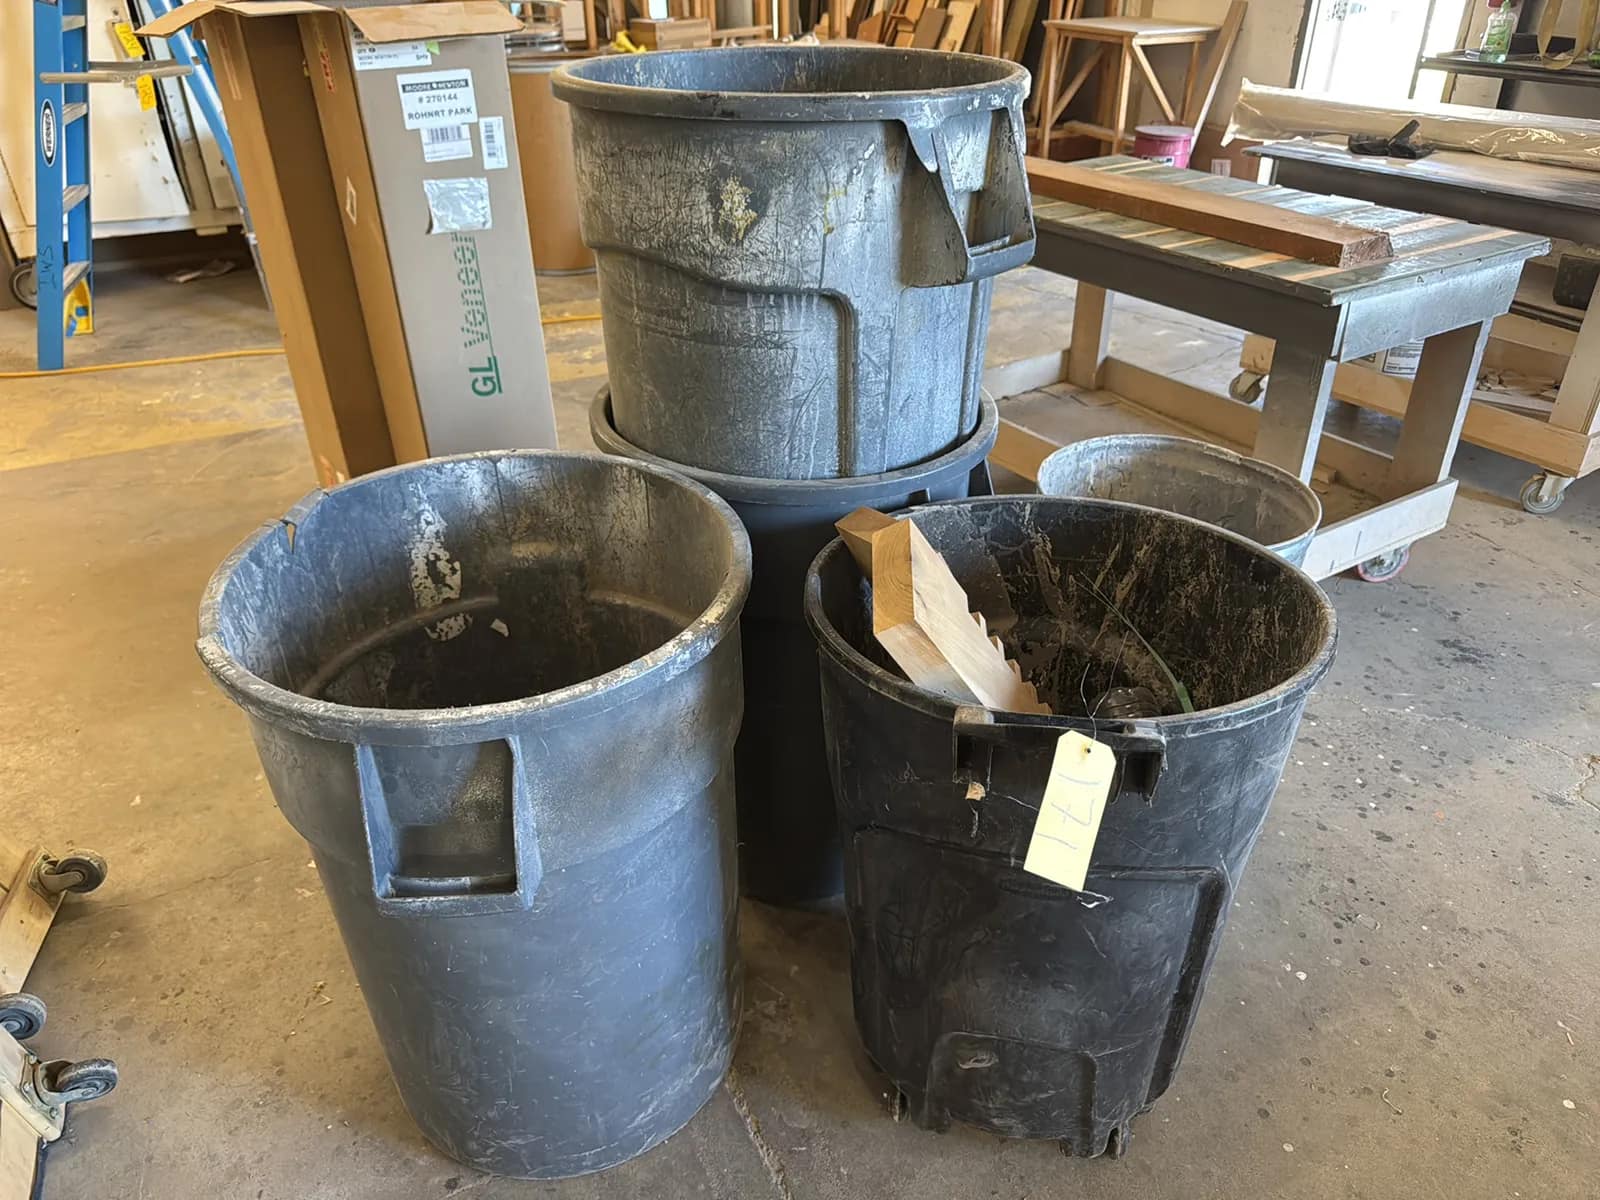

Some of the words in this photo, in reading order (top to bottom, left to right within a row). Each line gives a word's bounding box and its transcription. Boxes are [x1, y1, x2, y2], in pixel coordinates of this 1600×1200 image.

[404, 81, 432, 93] MOORE
[426, 93, 458, 104] 270144
[407, 109, 446, 121] ROHNRT
[448, 107, 473, 118] PARK
[44, 112, 53, 153] WERNER
[469, 356, 497, 397] GL
